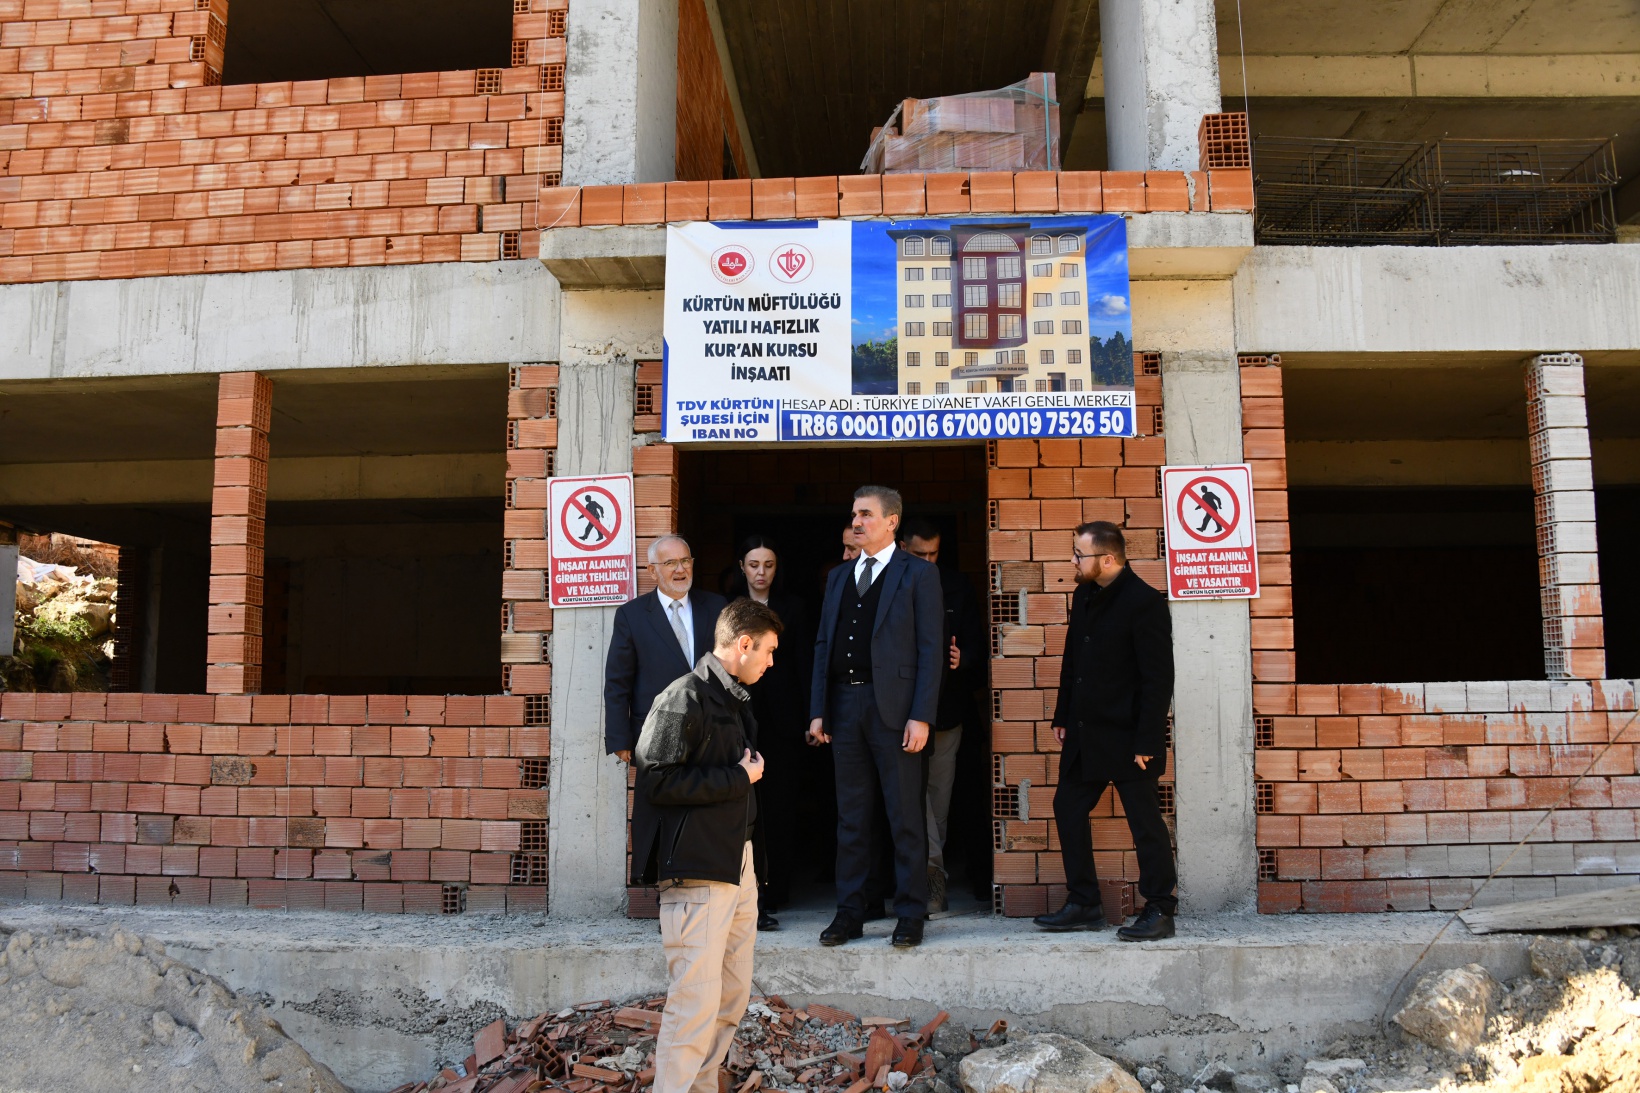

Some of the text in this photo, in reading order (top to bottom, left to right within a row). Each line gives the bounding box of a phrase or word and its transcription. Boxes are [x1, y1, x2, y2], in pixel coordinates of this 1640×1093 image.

[682, 293, 841, 312] KÜRTÜN MÜFTÜLÜĞÜ
[703, 318, 820, 334] YATILI HAFIZLIK
[766, 342, 818, 357] KURSU
[731, 363, 791, 382] İNŞAATI
[676, 397, 774, 411] TDV KÜRTÜN
[782, 398, 826, 411] HESAP
[829, 398, 853, 411] ADI
[863, 396, 919, 411] TÜRKİYE
[922, 396, 980, 409] DİYANET
[983, 396, 1022, 408] VAKFI
[1025, 395, 1071, 408] GENEL
[1073, 392, 1131, 407] MERKEZİ
[680, 411, 769, 427] ŞUBESİ İÇİN
[789, 410, 1124, 438] TR86 0001 0016 6700 0019 7526 50
[692, 428, 758, 439] IBAN NO
[1176, 551, 1248, 564] İNŞAAT ALANINA
[558, 559, 626, 572] İNŞAAT ALANINA
[1174, 562, 1252, 576] GİRMEK TEHLİKELİ
[555, 572, 588, 583] GİRMEK
[1186, 577, 1241, 588] VE YASAKTIR
[567, 585, 619, 595] VE YASAKTIR
